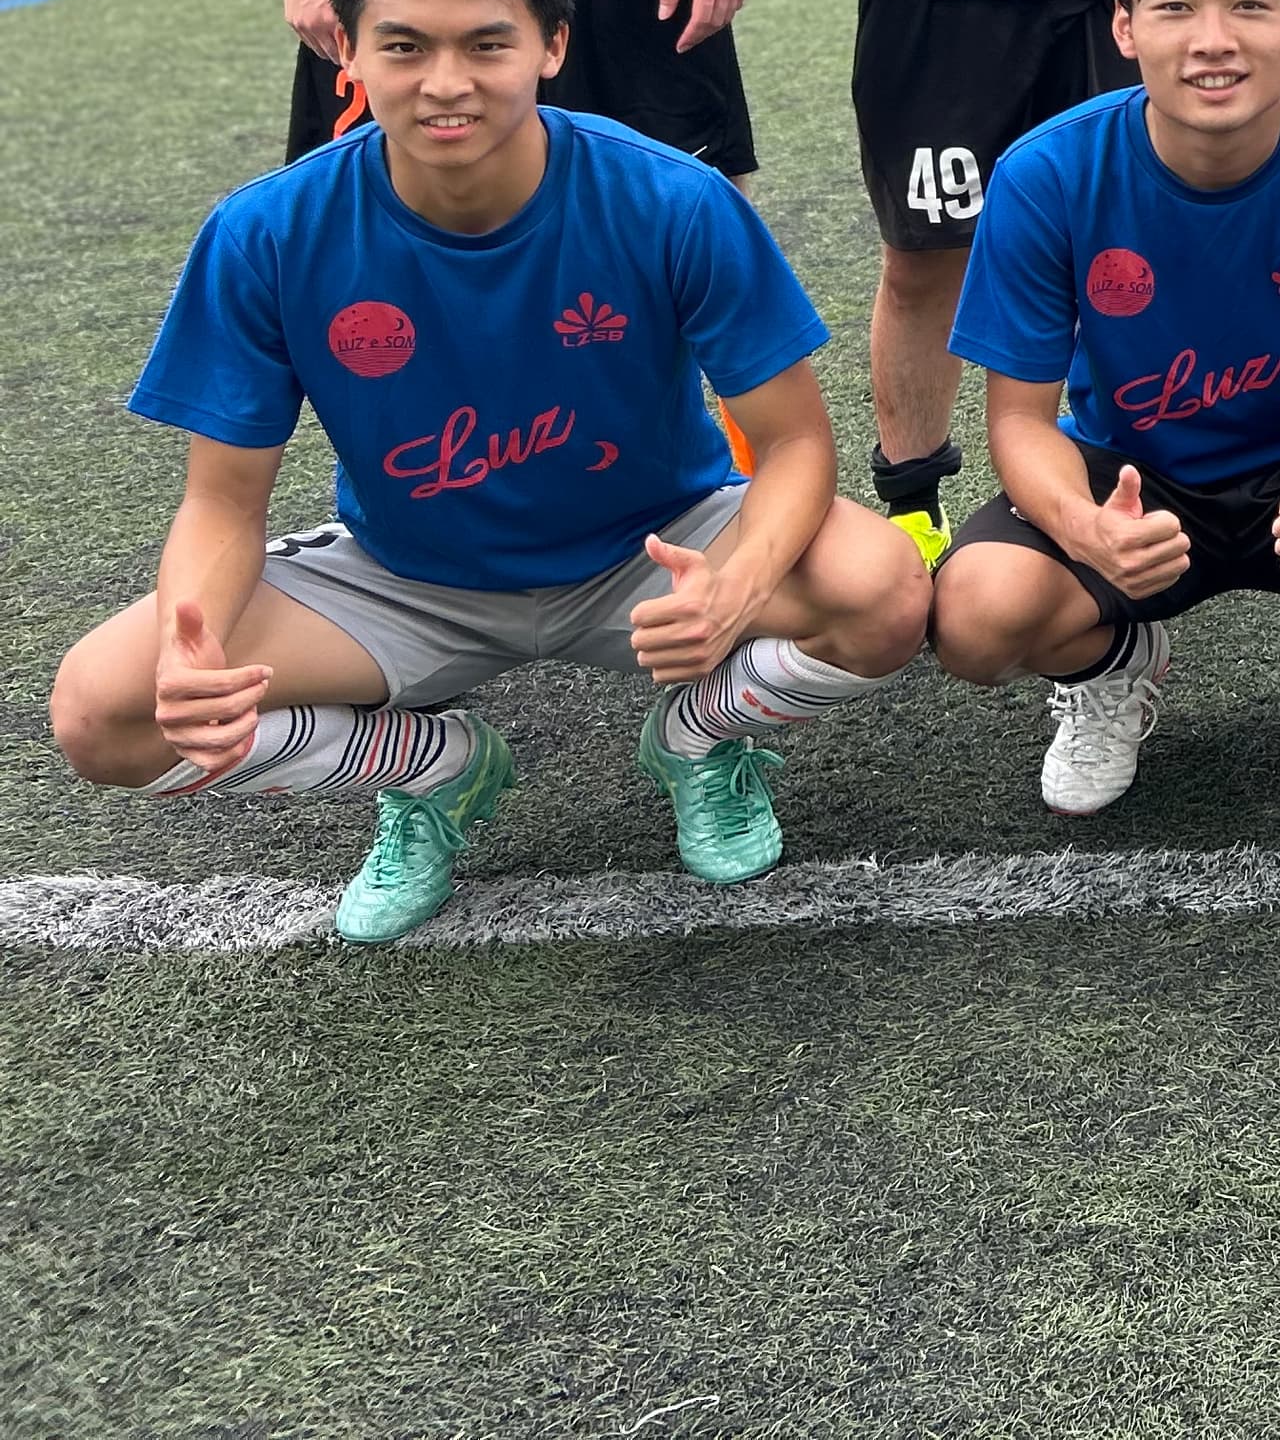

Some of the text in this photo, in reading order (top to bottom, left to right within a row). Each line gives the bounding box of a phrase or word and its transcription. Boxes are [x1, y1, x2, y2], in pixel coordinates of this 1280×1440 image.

[907, 147, 984, 224] 49
[337, 336, 366, 353] LUZ
[562, 331, 625, 348] LZSB
[383, 406, 575, 498] Luz
